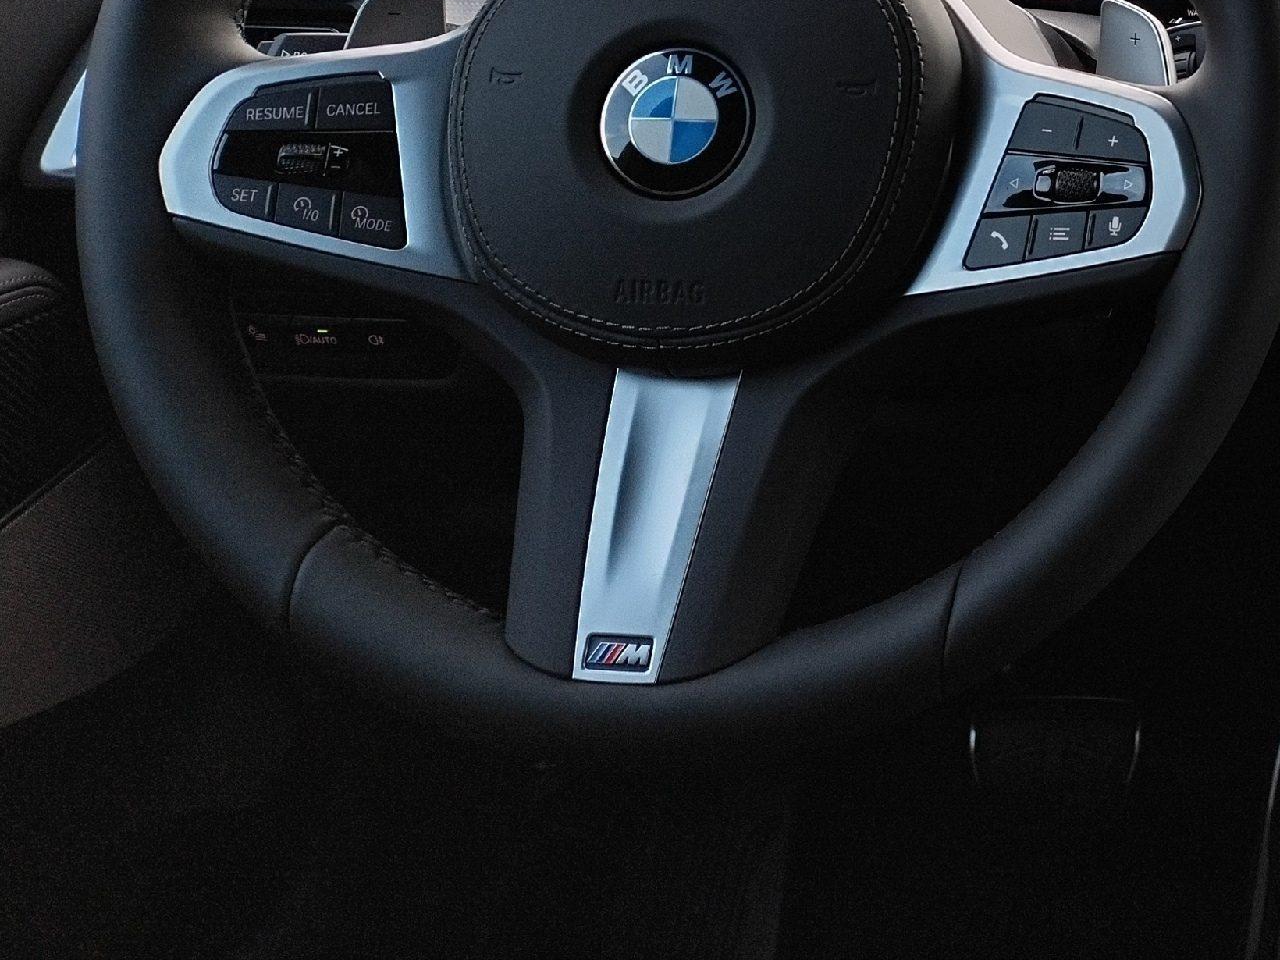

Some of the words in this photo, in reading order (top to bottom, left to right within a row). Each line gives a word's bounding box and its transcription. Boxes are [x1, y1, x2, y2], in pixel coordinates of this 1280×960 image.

[622, 54, 738, 99] BMW
[246, 106, 304, 121] RESUME
[326, 102, 381, 117] CANCEL
[230, 189, 258, 202] SET
[354, 217, 393, 232] MODE
